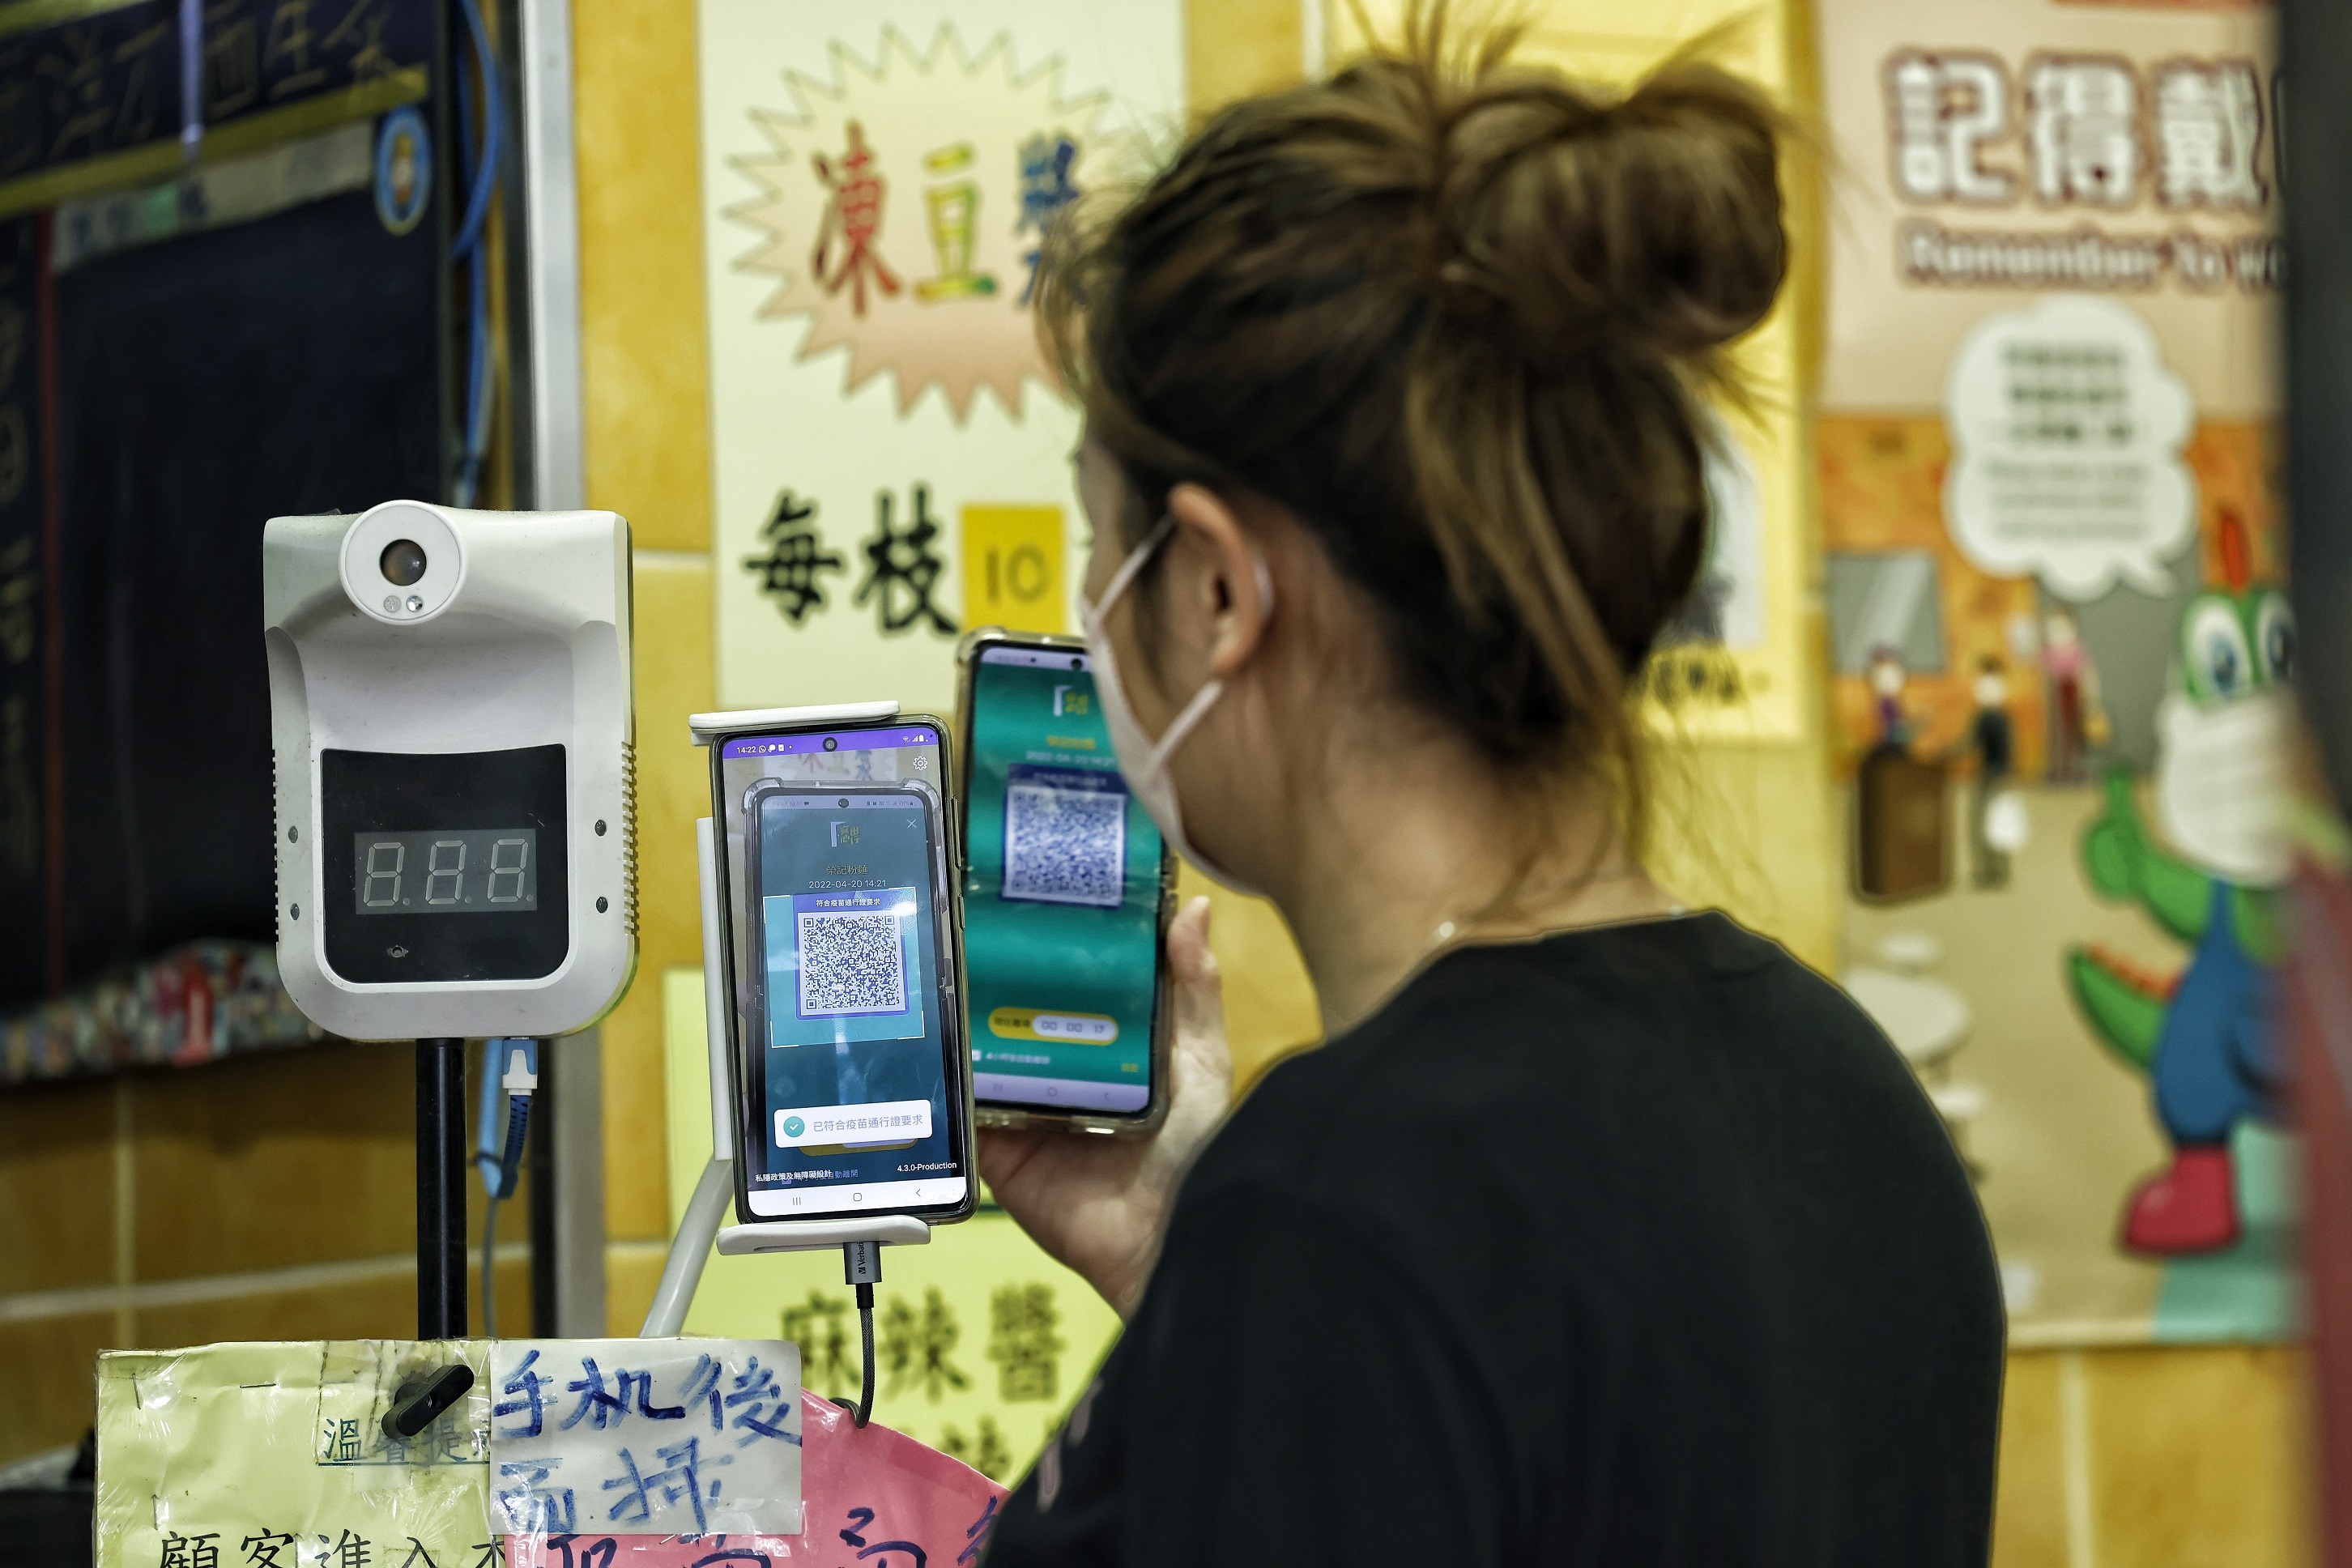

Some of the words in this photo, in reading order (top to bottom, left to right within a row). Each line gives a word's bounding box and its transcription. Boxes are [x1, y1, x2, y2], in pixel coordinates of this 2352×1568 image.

[1882, 47, 2286, 209] 記得戴
[742, 484, 959, 635] 每枝
[984, 544, 1051, 606] 10
[736, 745, 756, 754] 14:22
[808, 880, 863, 888] 2022-04-20
[864, 879, 887, 888] 14:21
[816, 897, 880, 907] 符合疫苗通行證要求
[813, 1114, 923, 1132] 已符合疫苗通行證要求
[897, 1161, 957, 1172] 4.3.0-Production
